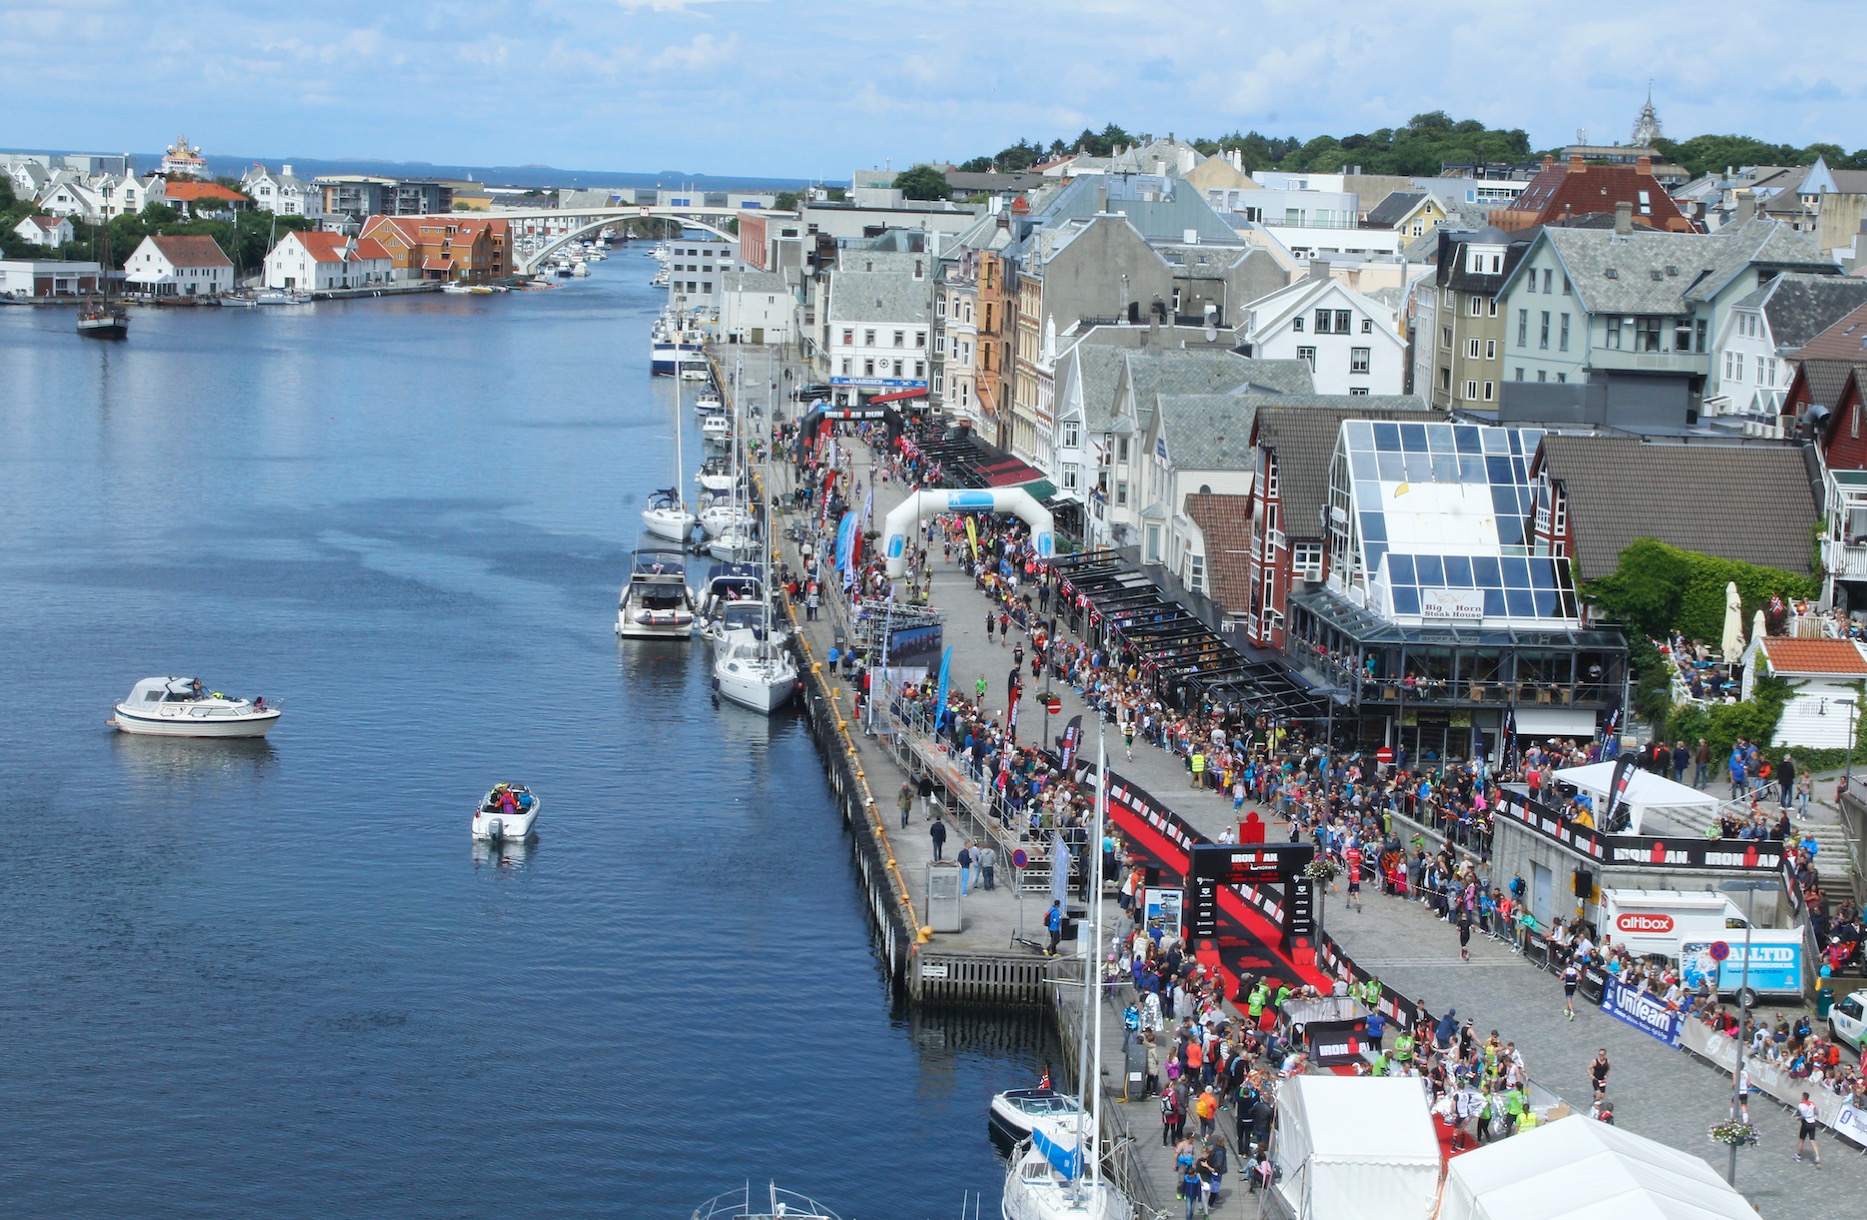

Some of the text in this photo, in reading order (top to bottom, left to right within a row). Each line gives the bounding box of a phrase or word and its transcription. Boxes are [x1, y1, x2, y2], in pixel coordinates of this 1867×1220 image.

[1425, 604, 1481, 612] Big Horn
[1231, 849, 1279, 863] IRONMAN
[1613, 842, 1688, 864] IRONMAN
[1704, 845, 1780, 867] IRONMAN
[1620, 916, 1669, 930] altibox
[1727, 947, 1794, 961] ALLTID
